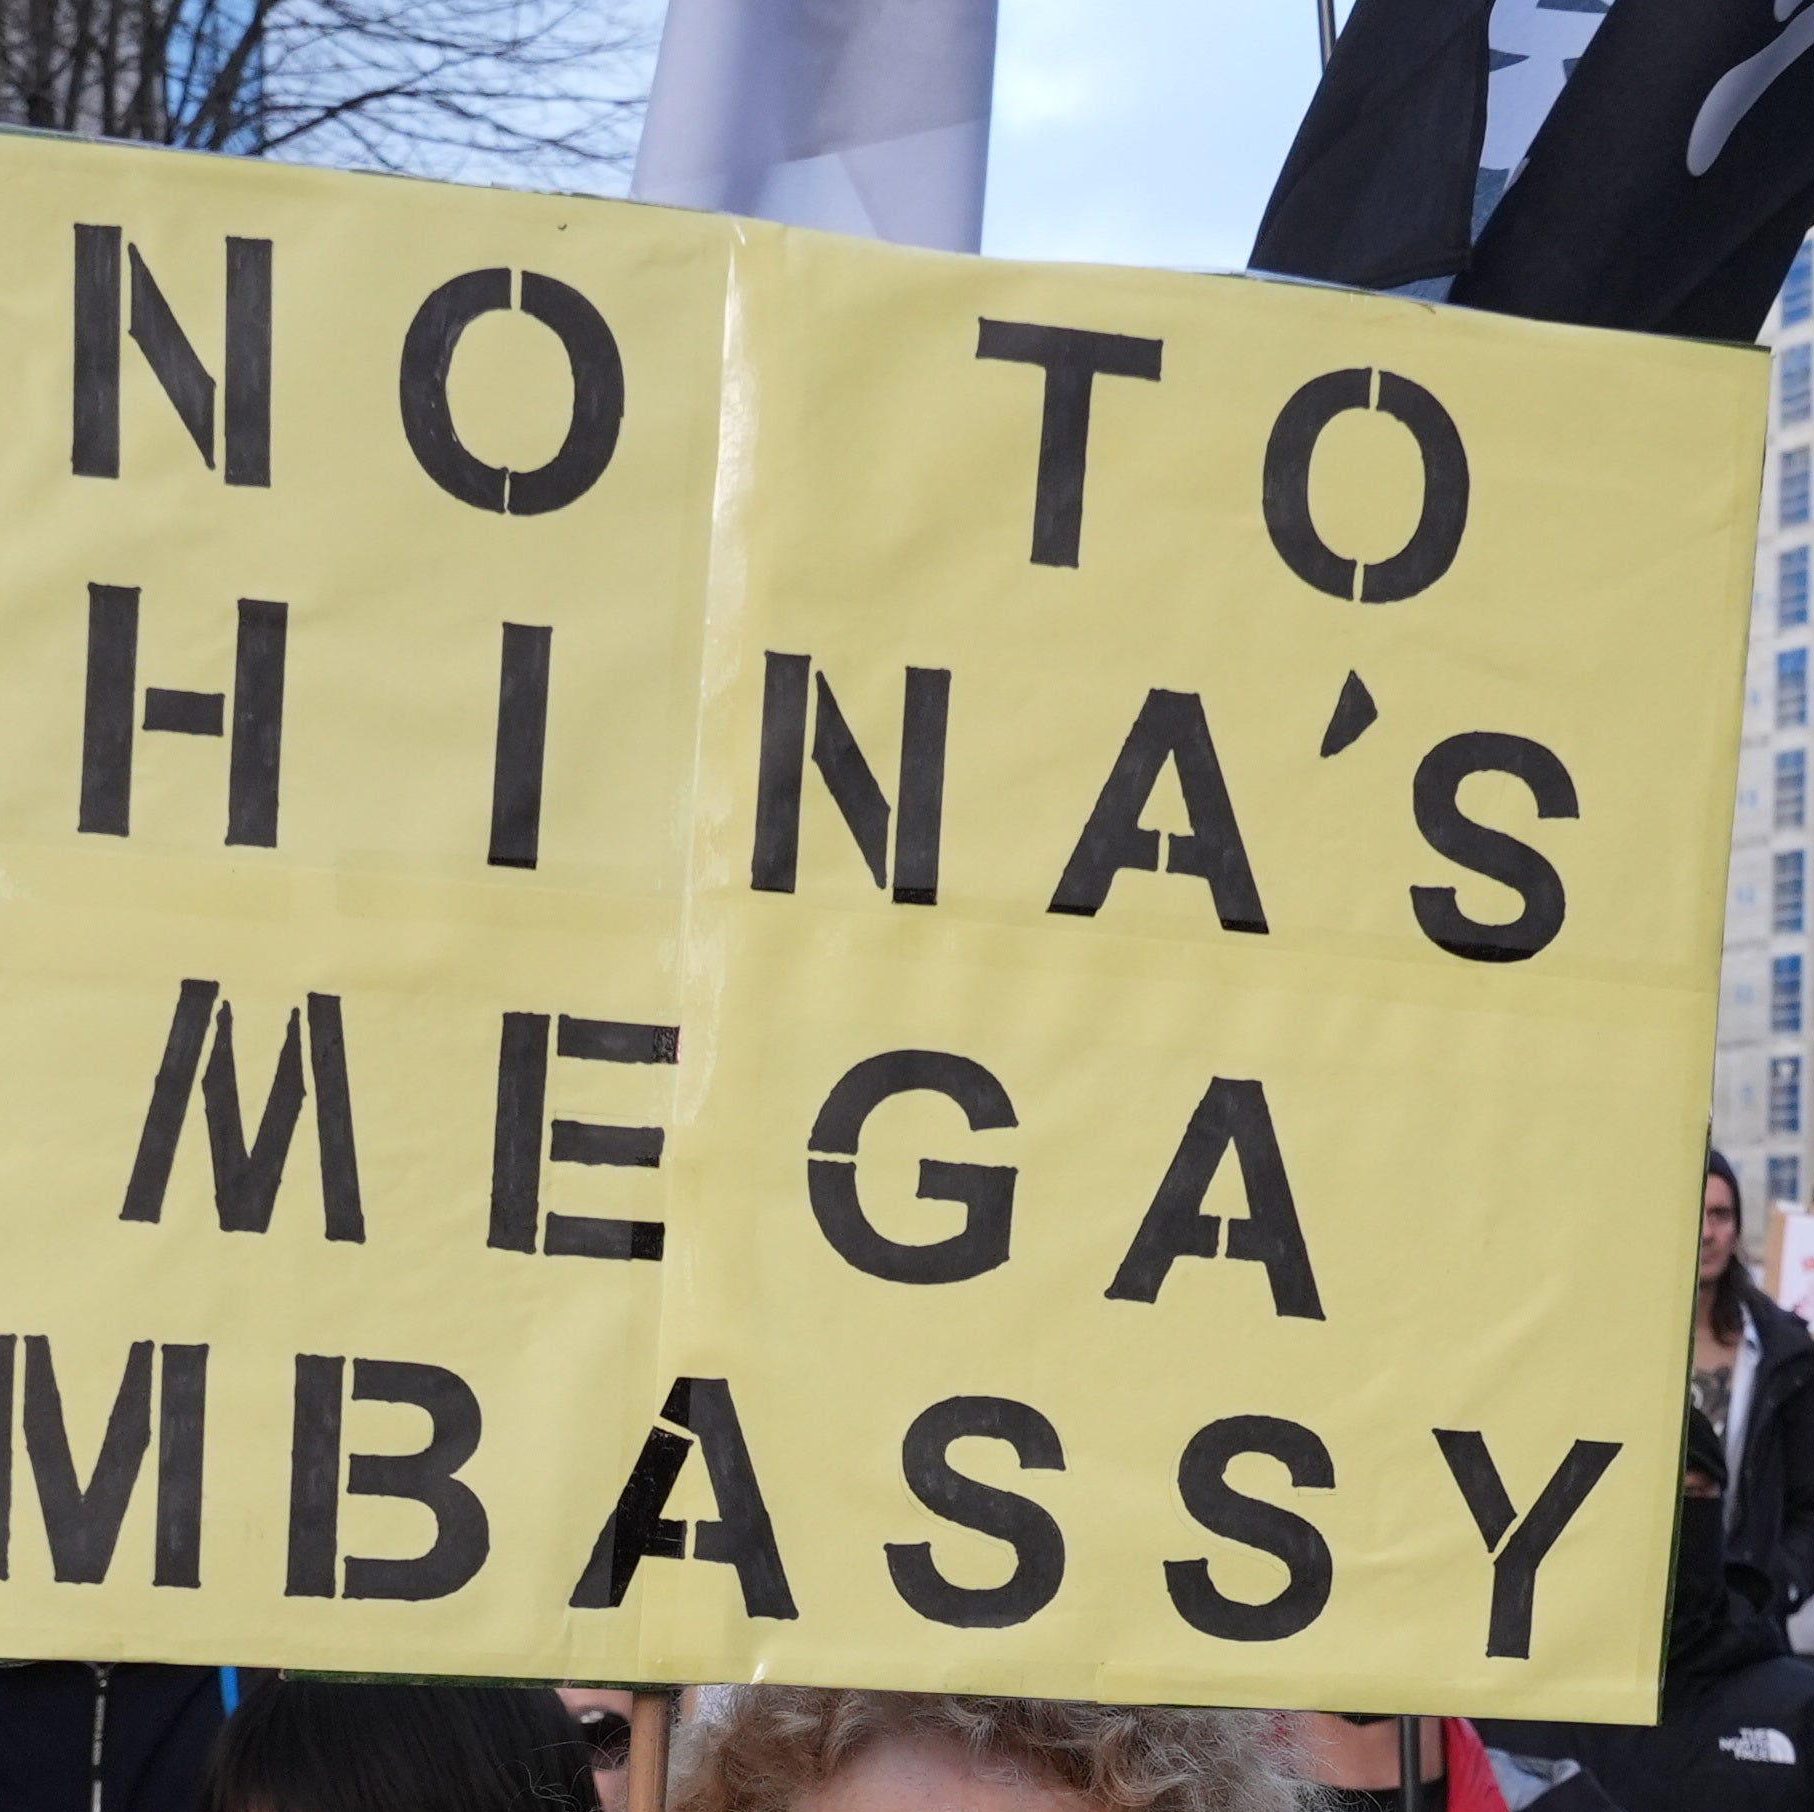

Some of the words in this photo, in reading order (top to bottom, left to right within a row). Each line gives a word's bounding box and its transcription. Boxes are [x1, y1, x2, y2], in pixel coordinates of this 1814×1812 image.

[71, 223, 625, 516] NO
[975, 316, 1472, 604] TO
[118, 977, 1325, 1320] MEGA
